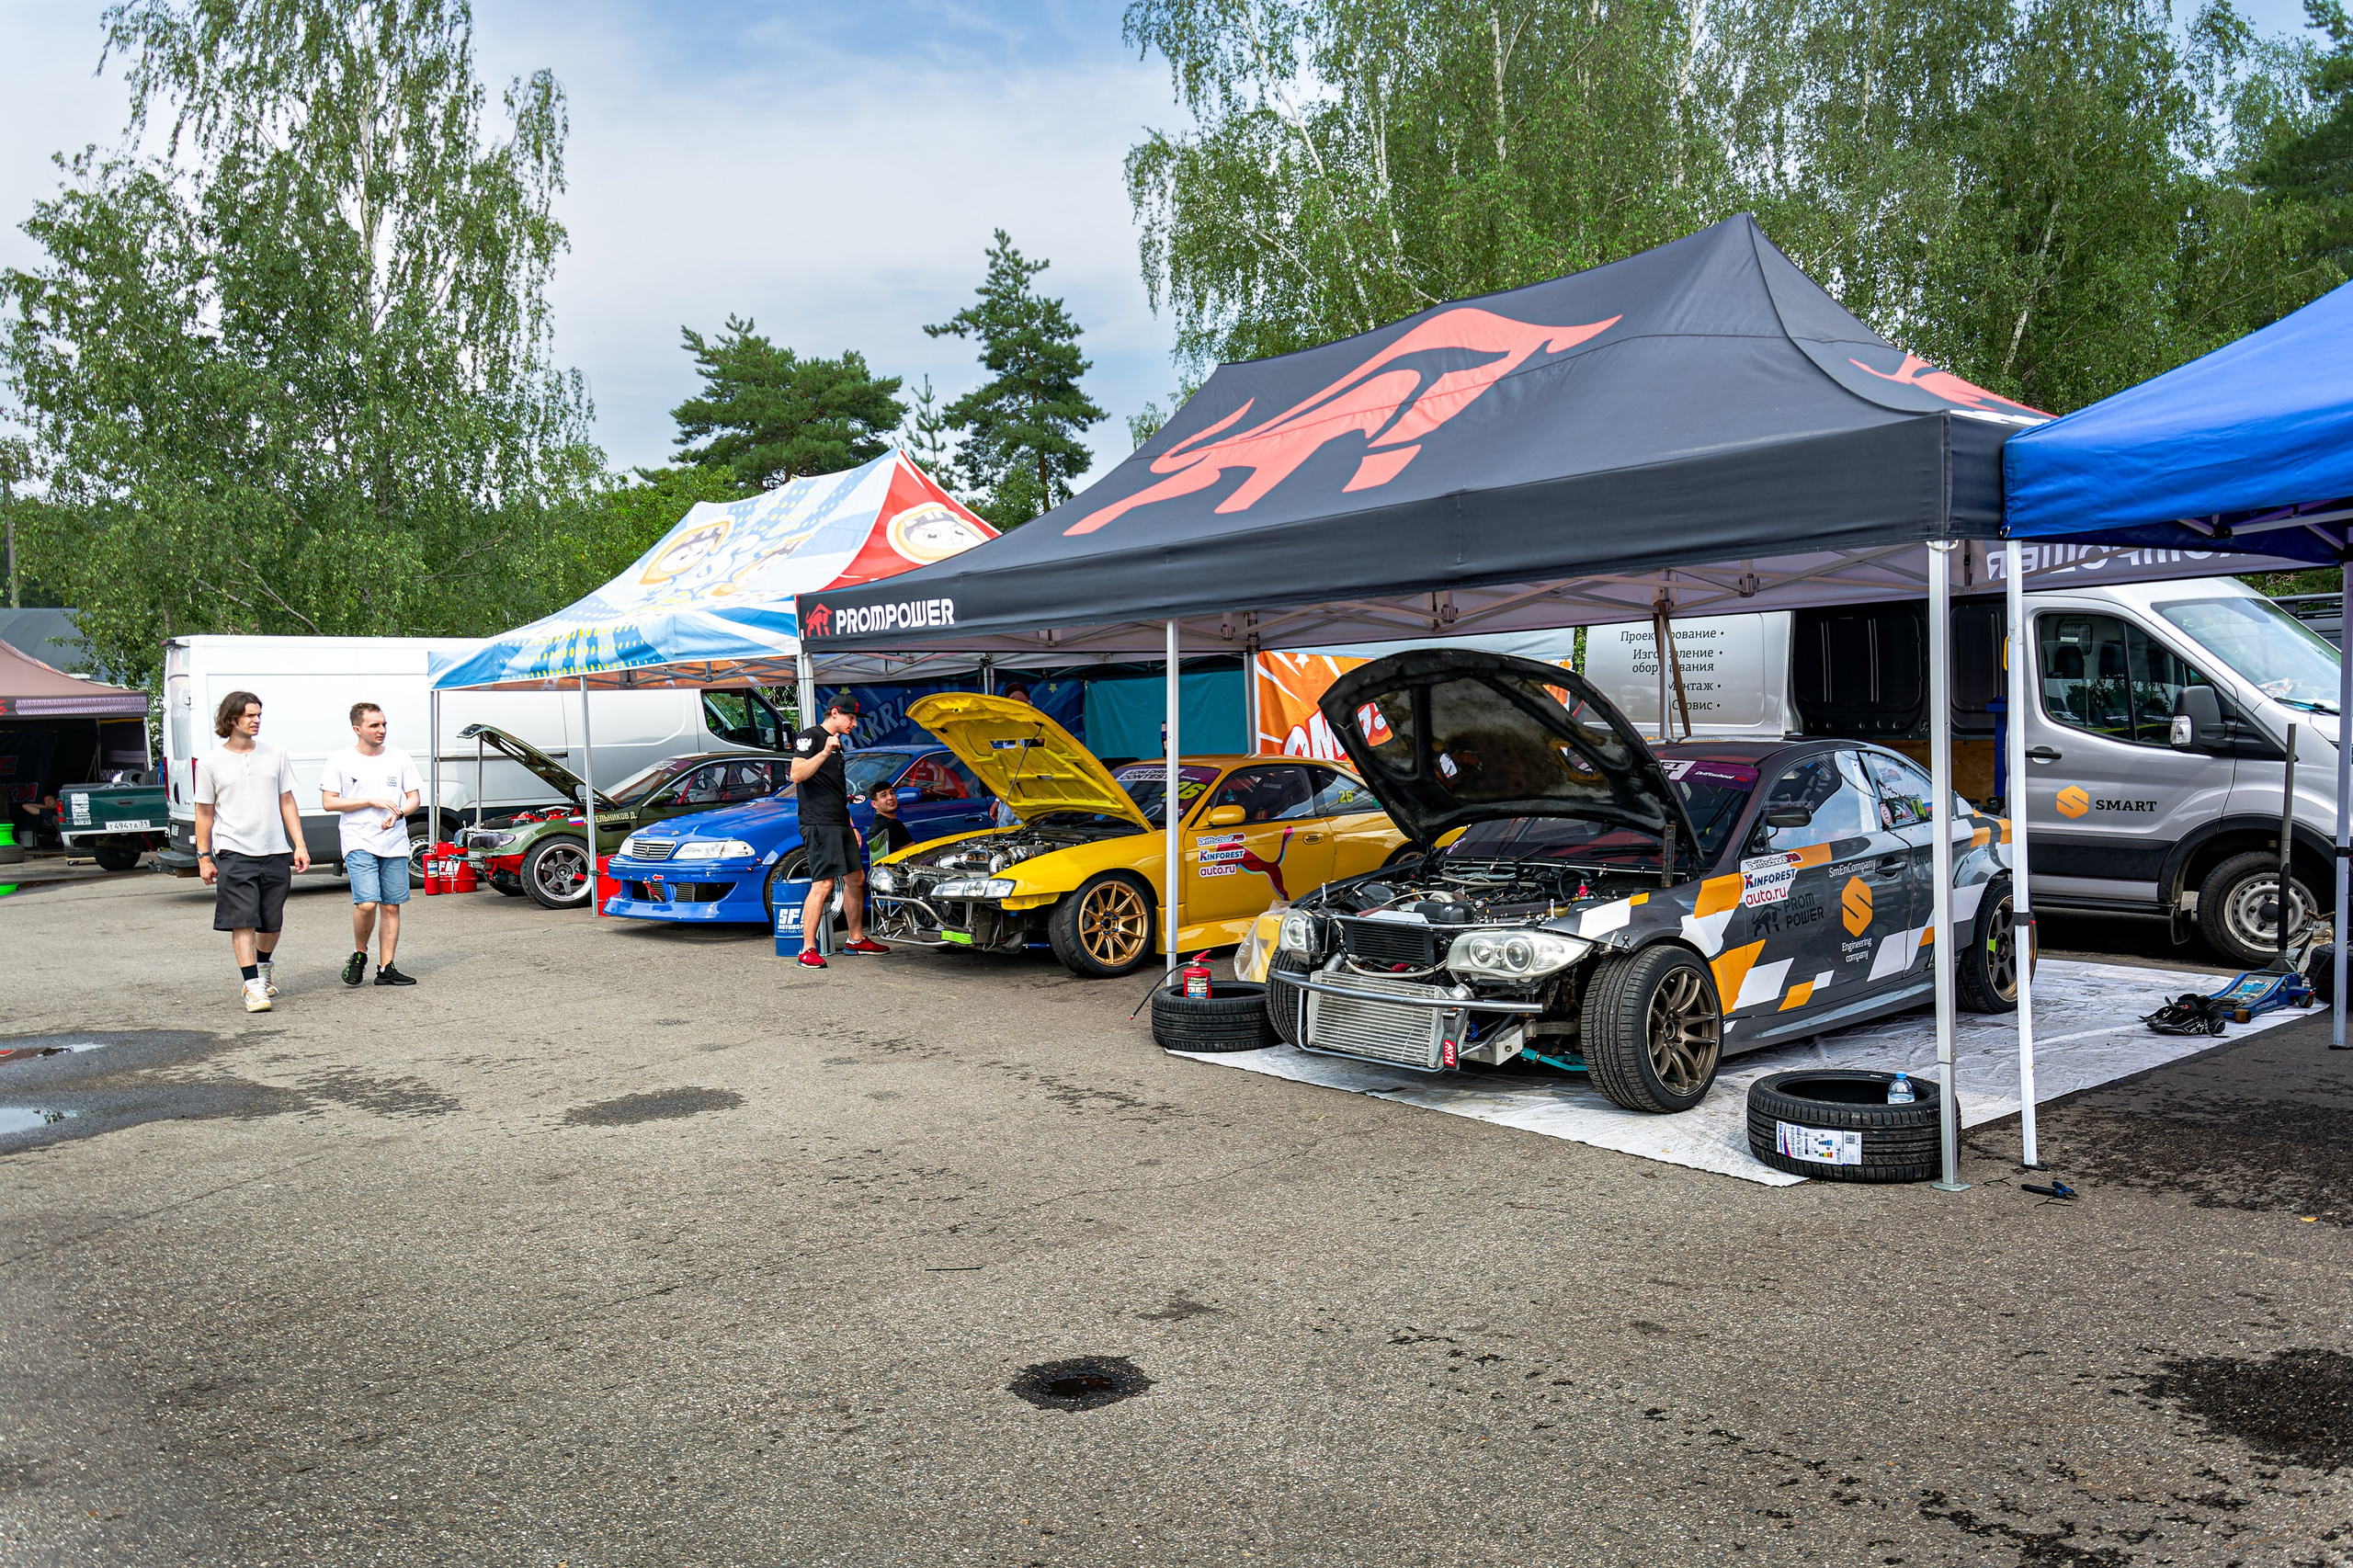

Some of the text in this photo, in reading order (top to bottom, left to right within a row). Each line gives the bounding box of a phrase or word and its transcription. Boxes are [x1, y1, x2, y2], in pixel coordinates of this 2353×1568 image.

[835, 598, 955, 635] PROMPOWER
[1672, 699, 1713, 712] Срвис
[1338, 790, 1354, 803] 26
[2095, 799, 2157, 812] SMART
[1199, 865, 1235, 876] auto.ru
[1828, 858, 1877, 878] SmEnCompany
[1745, 886, 1787, 906] auto.ru
[1783, 892, 1815, 914] PROM
[1786, 905, 1824, 929] POWER
[1841, 937, 1872, 952] Engineering
[1846, 949, 1870, 963] company
